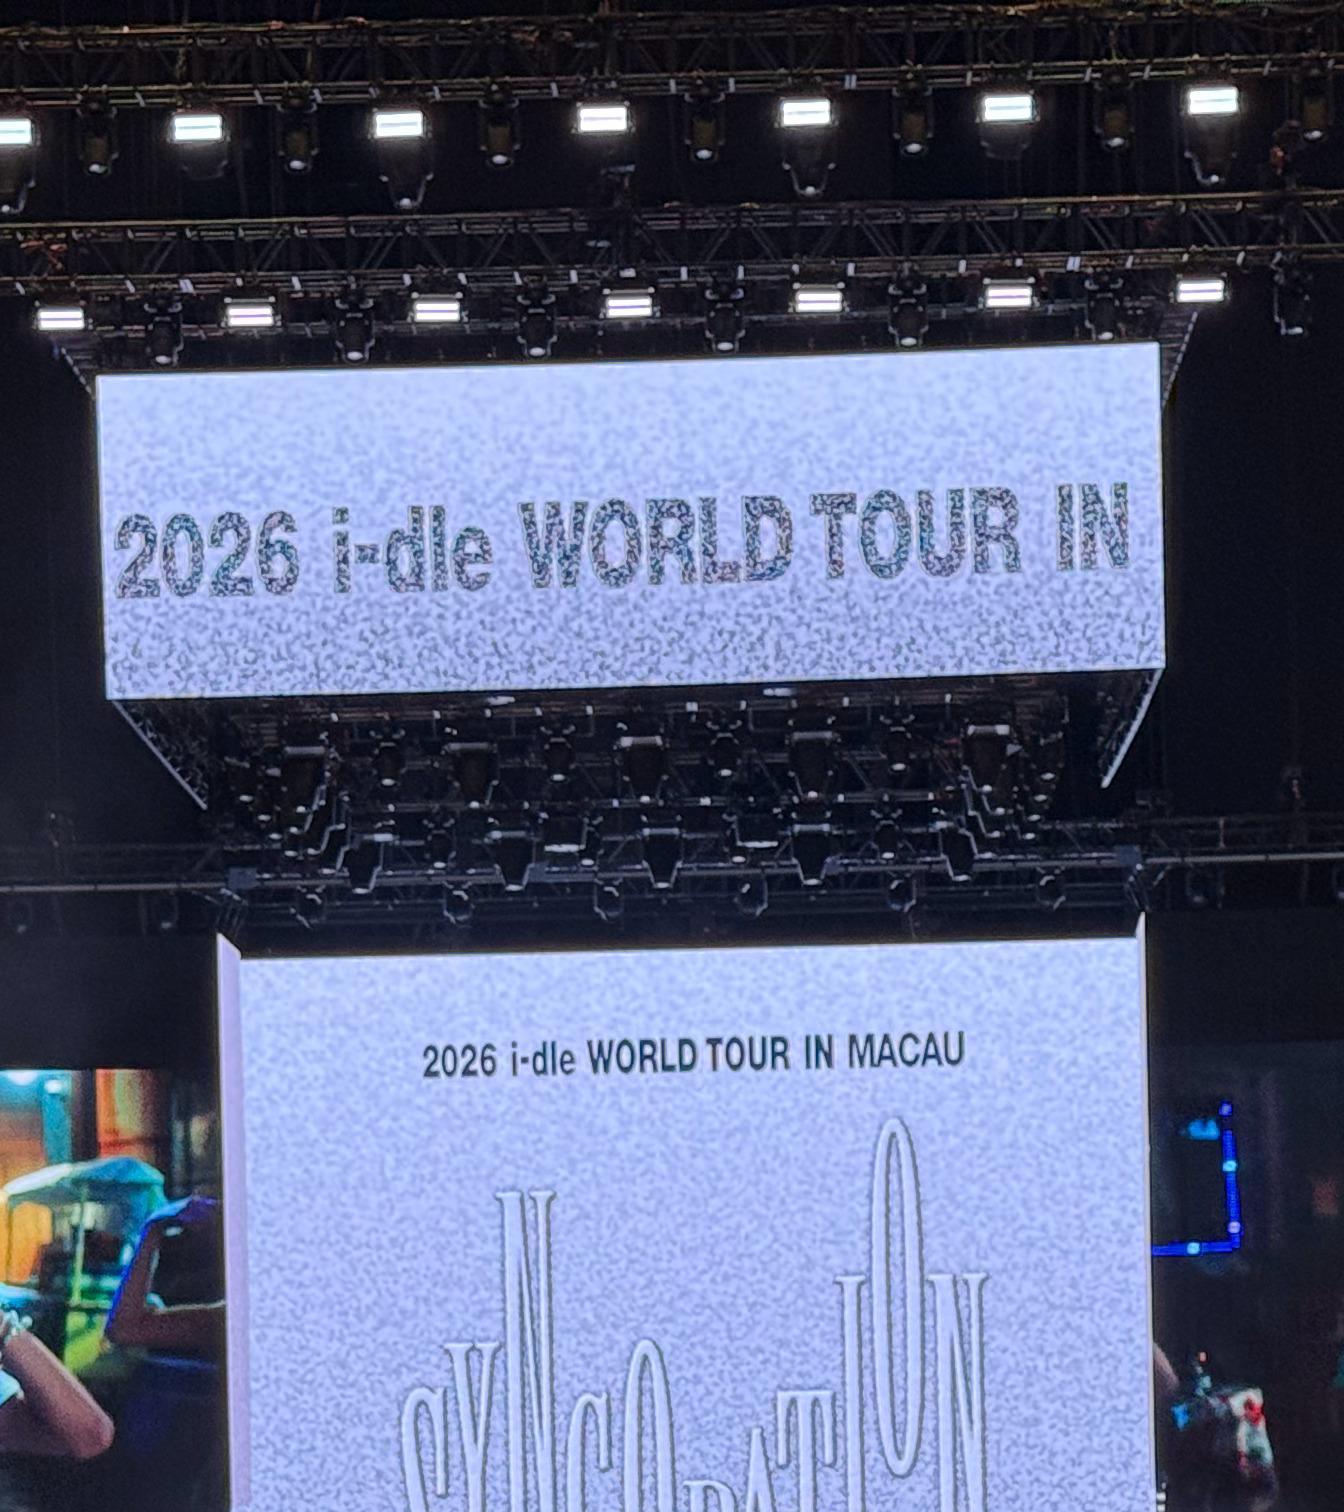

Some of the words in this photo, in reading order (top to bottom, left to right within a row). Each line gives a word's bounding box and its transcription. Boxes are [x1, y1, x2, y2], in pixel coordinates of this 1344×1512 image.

[113, 510, 300, 598] 2026
[331, 505, 494, 594] i-dle
[517, 494, 795, 589] WORLD
[809, 485, 1024, 582] TOUR
[1055, 481, 1131, 572] IN
[422, 1044, 497, 1078] 2026
[511, 1041, 576, 1077] i-dle
[586, 1038, 697, 1075] WORLD
[705, 1036, 790, 1072] TOUR
[806, 1034, 834, 1070] IN
[848, 1031, 966, 1068] MACAU
